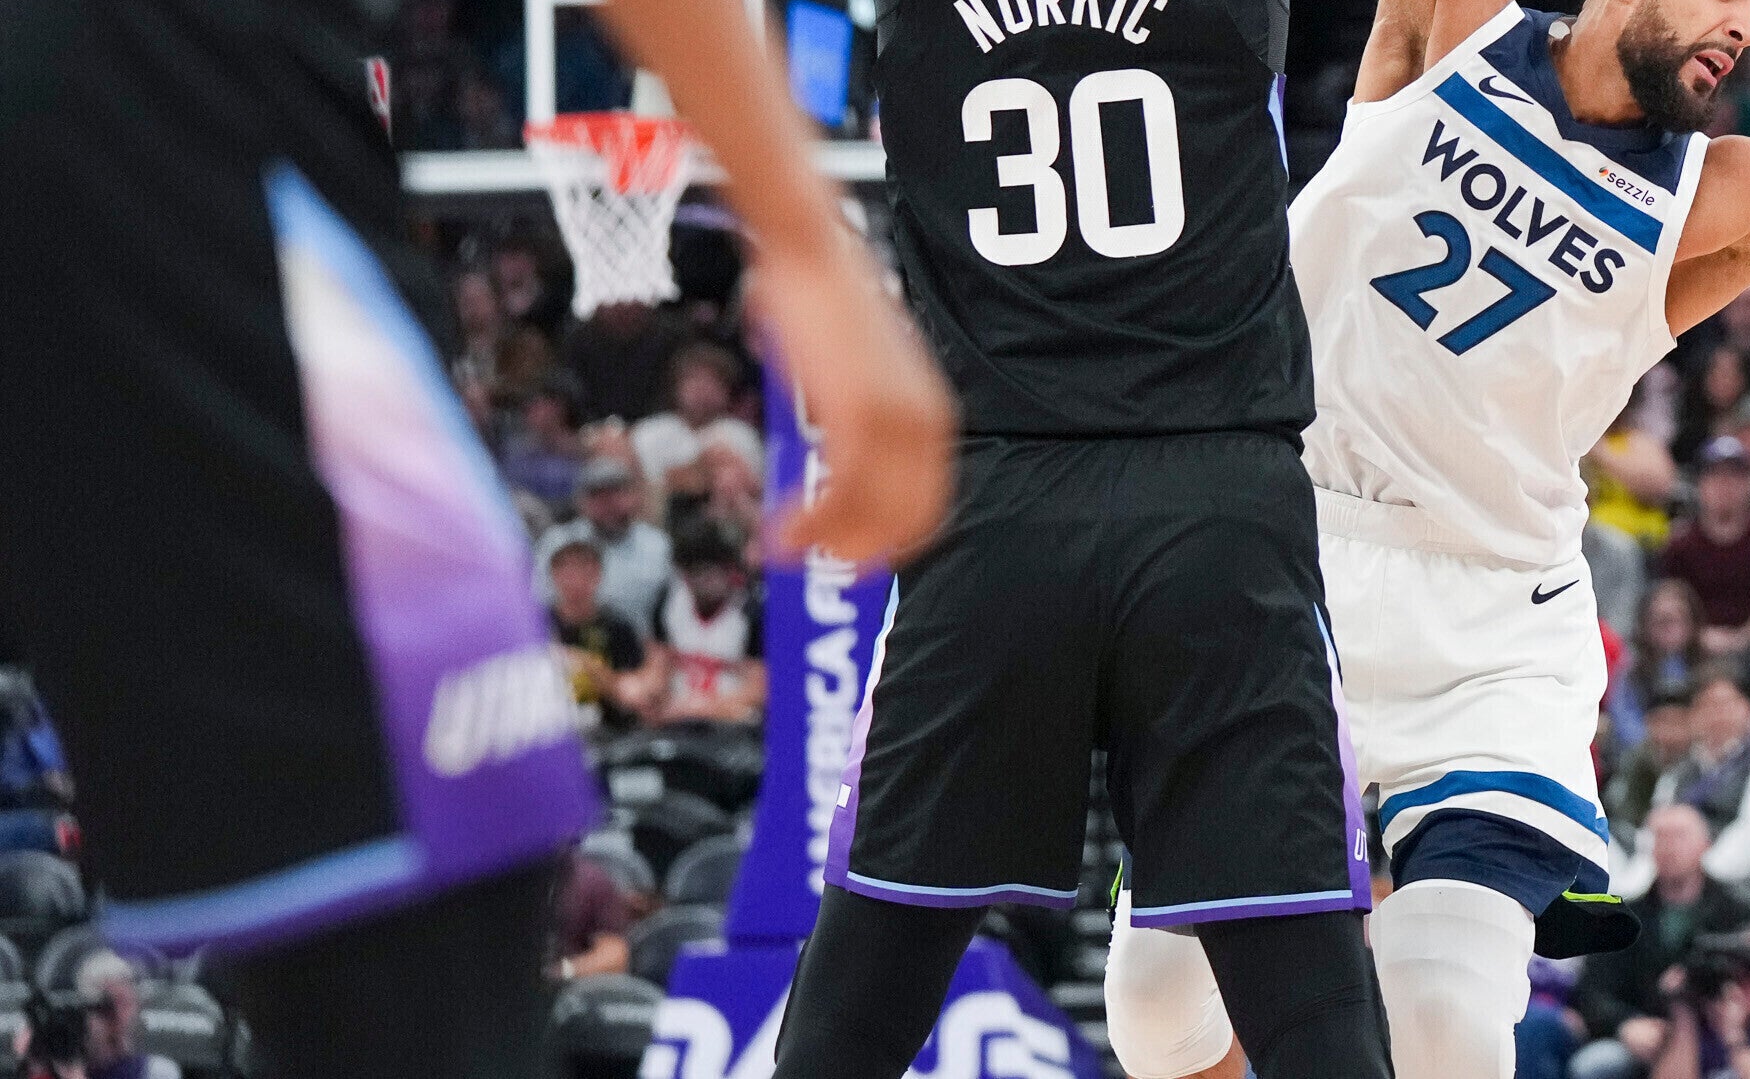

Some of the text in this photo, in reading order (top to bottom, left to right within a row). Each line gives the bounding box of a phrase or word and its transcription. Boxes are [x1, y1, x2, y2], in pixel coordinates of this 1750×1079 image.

[961, 68, 1186, 267] 30
[1421, 119, 1627, 294] WOLVES
[1606, 170, 1656, 207] sezzle
[1369, 209, 1558, 357] 27
